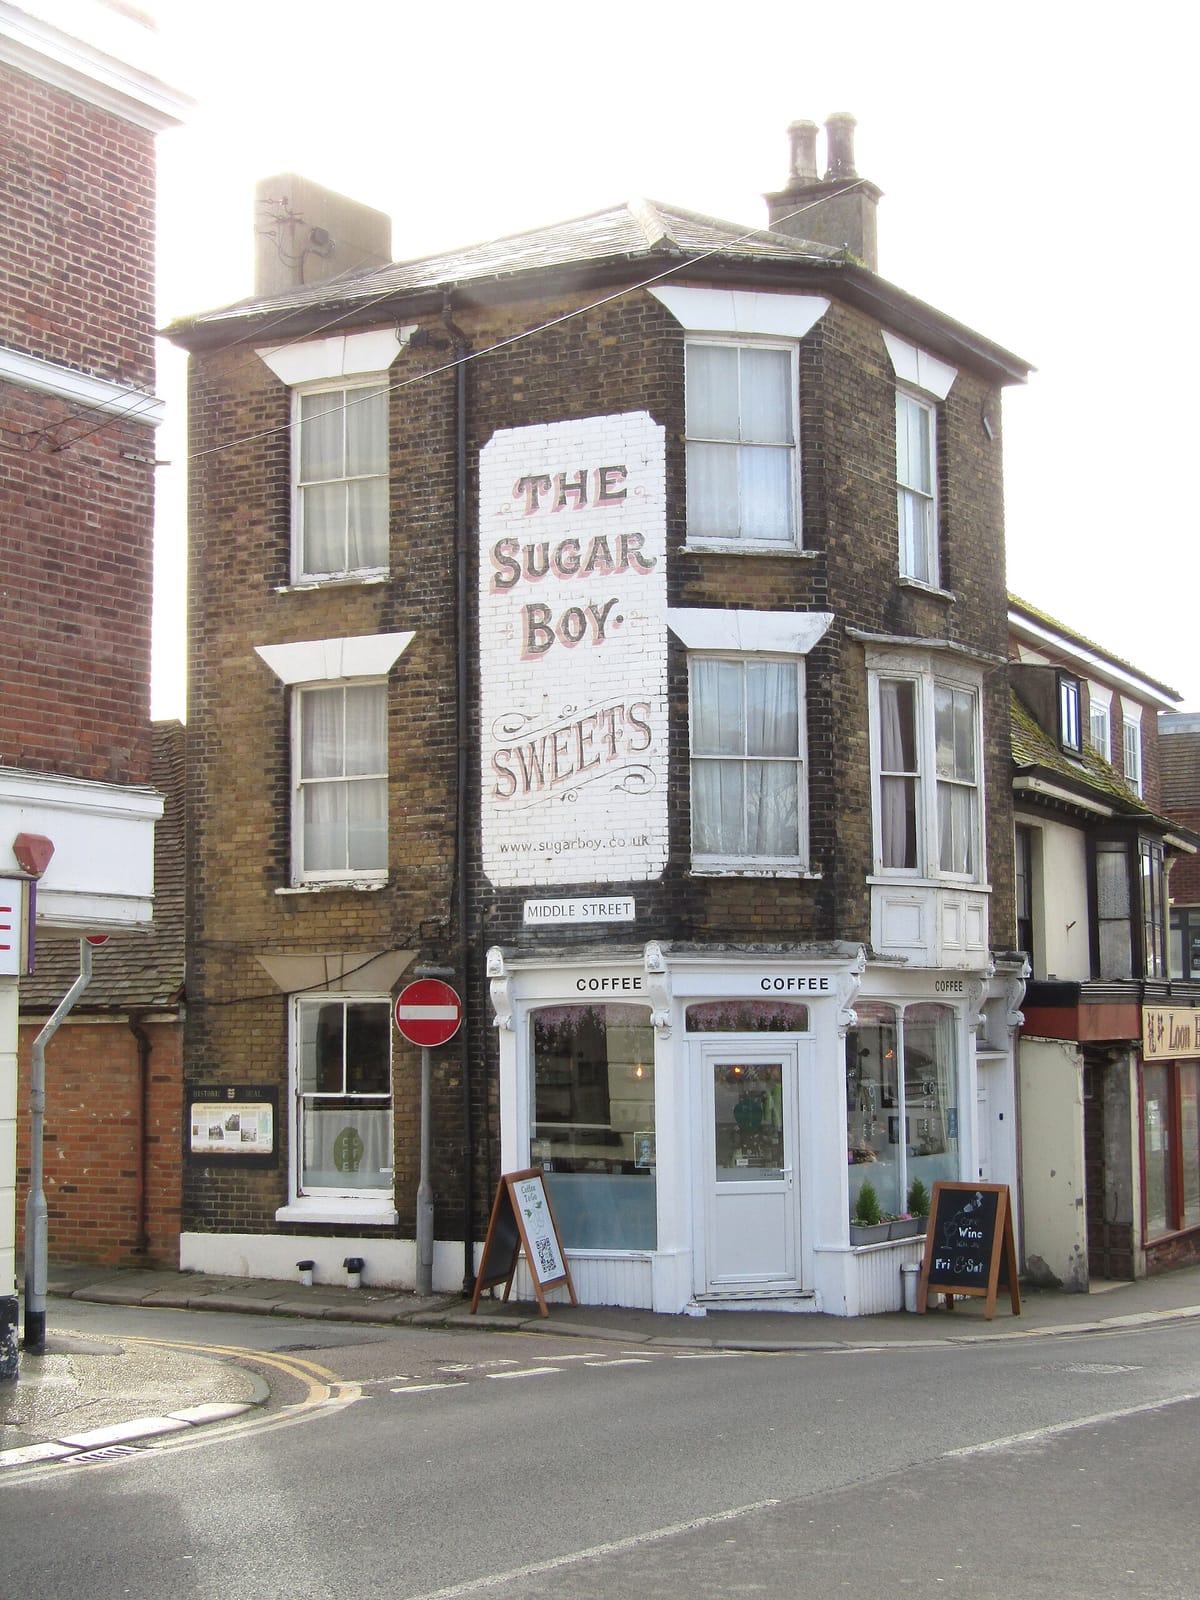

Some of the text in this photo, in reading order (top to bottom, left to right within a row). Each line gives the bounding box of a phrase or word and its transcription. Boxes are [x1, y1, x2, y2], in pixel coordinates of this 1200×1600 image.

[512, 465, 628, 516] THE
[489, 532, 657, 595] SUGAR
[491, 701, 652, 800] SWEETS
[528, 903, 631, 918] MIDDLE STREET
[576, 977, 642, 991] COFFEE
[760, 977, 829, 991] COFFEE
[935, 980, 963, 991] COFFEE
[958, 1226, 983, 1238] Wine
[935, 1258, 951, 1270] Fri
[966, 1258, 984, 1273] Sat
